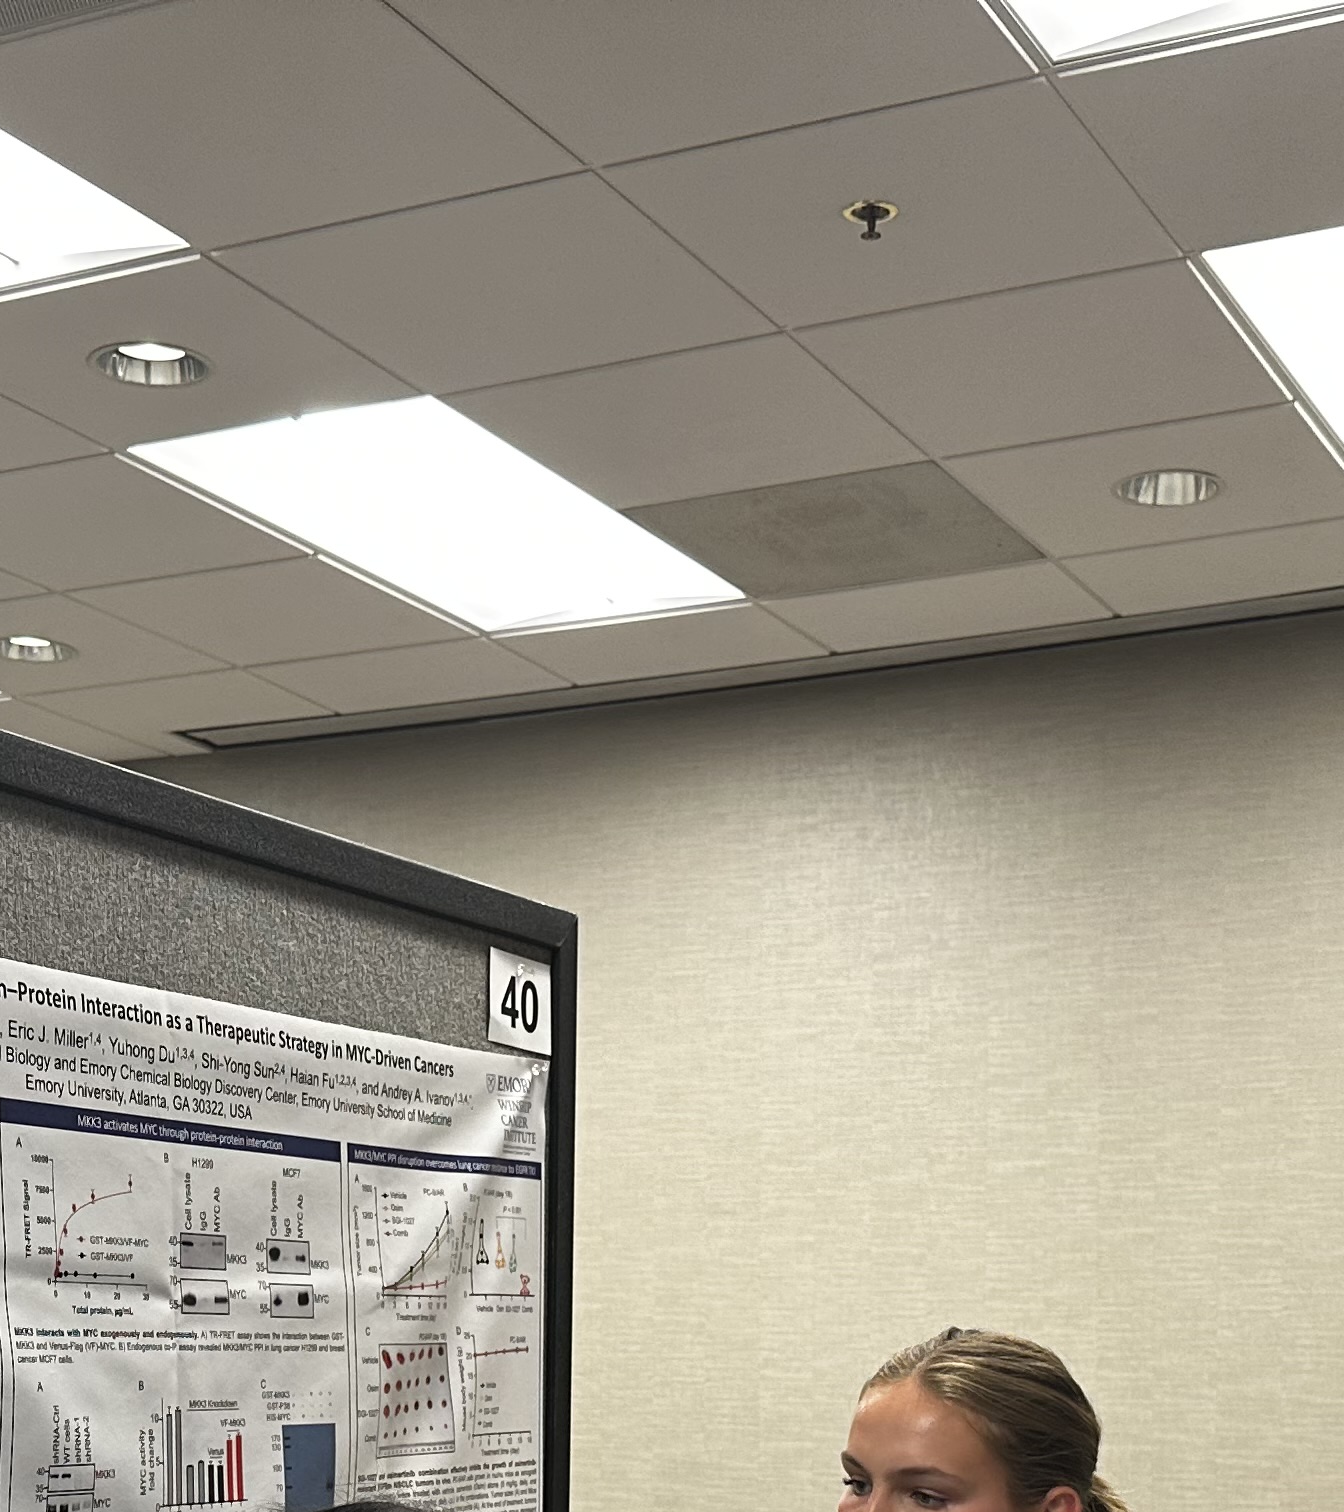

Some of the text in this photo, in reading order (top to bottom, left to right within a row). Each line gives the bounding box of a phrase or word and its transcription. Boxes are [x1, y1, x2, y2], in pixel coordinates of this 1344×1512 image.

[80, 992, 162, 1027] Interaction
[165, 1013, 182, 1030] as
[184, 1016, 193, 1033] a
[195, 1014, 276, 1048] Therapeutic
[278, 1030, 329, 1061] Strategy
[331, 1039, 343, 1060] in
[345, 1042, 412, 1071] MYC-Driven
[413, 1055, 454, 1080] Cancers
[501, 975, 540, 1034] 40
[5, 1045, 52, 1073] Biology
[53, 1055, 76, 1073] and
[79, 1057, 118, 1082] Emory
[119, 1063, 171, 1088] Chemical
[173, 1071, 213, 1096] Biology
[214, 1077, 263, 1104] Discovery
[264, 1085, 299, 1108] Center,
[301, 1091, 331, 1114] Emory
[332, 1096, 375, 1120] University
[376, 1103, 406, 1121] School
[407, 1108, 416, 1122] of
[8, 1019, 35, 1041] Eric
[108, 1035, 158, 1068] Yuhong
[201, 1051, 251, 1080] Shi-Yong
[290, 1066, 319, 1087] Haian
[361, 1080, 382, 1097] and
[380, 1081, 414, 1105] Andrey
[25, 1073, 65, 1099] Emory
[67, 1079, 126, 1107] University,
[128, 1087, 170, 1112] Atlanta,
[172, 1094, 190, 1112] GA
[229, 1102, 253, 1121] USA
